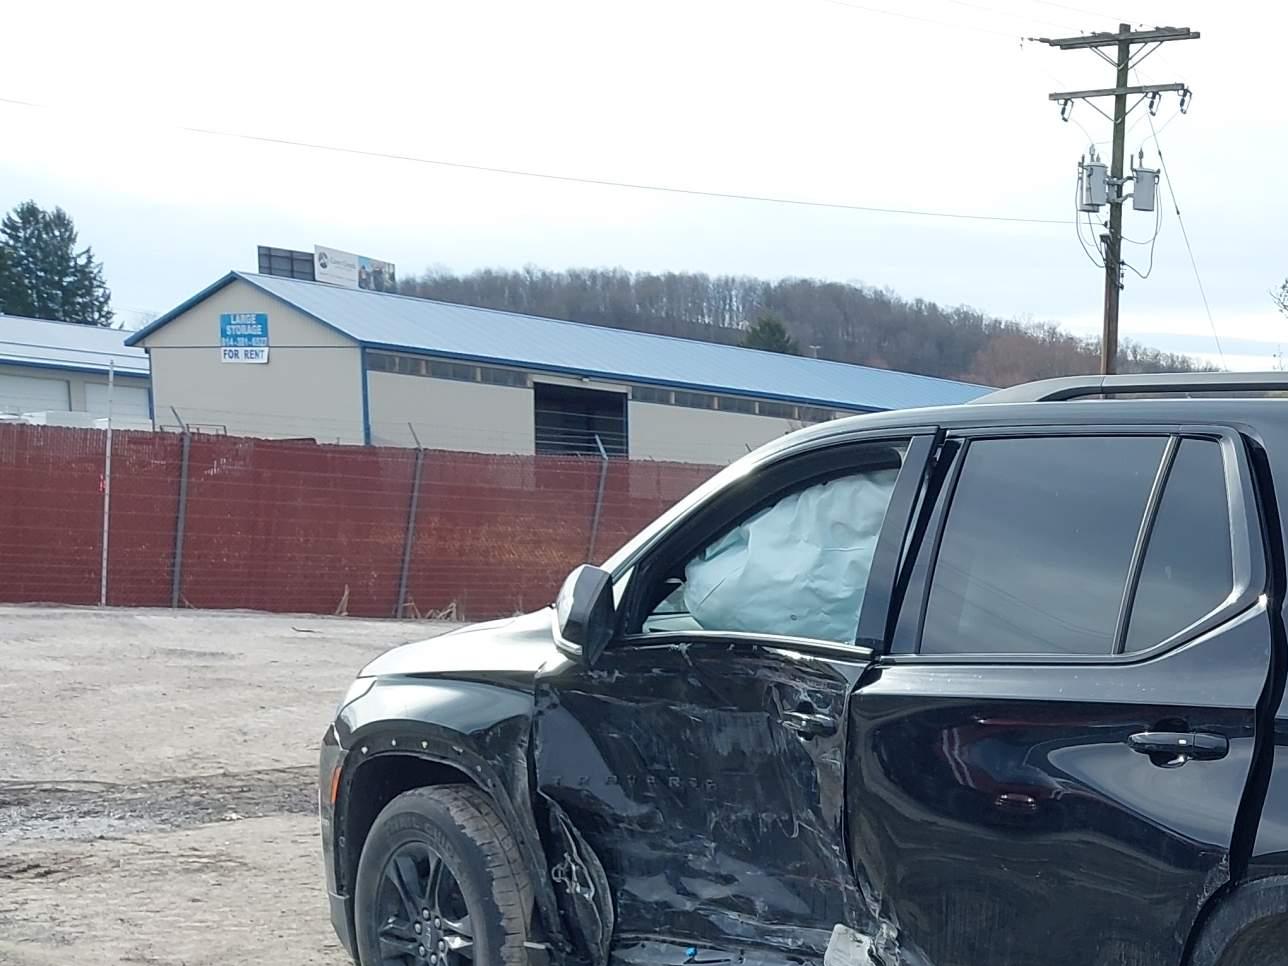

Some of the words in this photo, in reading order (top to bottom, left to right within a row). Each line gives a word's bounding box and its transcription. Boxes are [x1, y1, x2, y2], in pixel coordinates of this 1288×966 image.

[230, 313, 257, 324] LARGE
[226, 324, 263, 335] STORAGE
[223, 349, 240, 359] FOR
[243, 349, 265, 359] RENT
